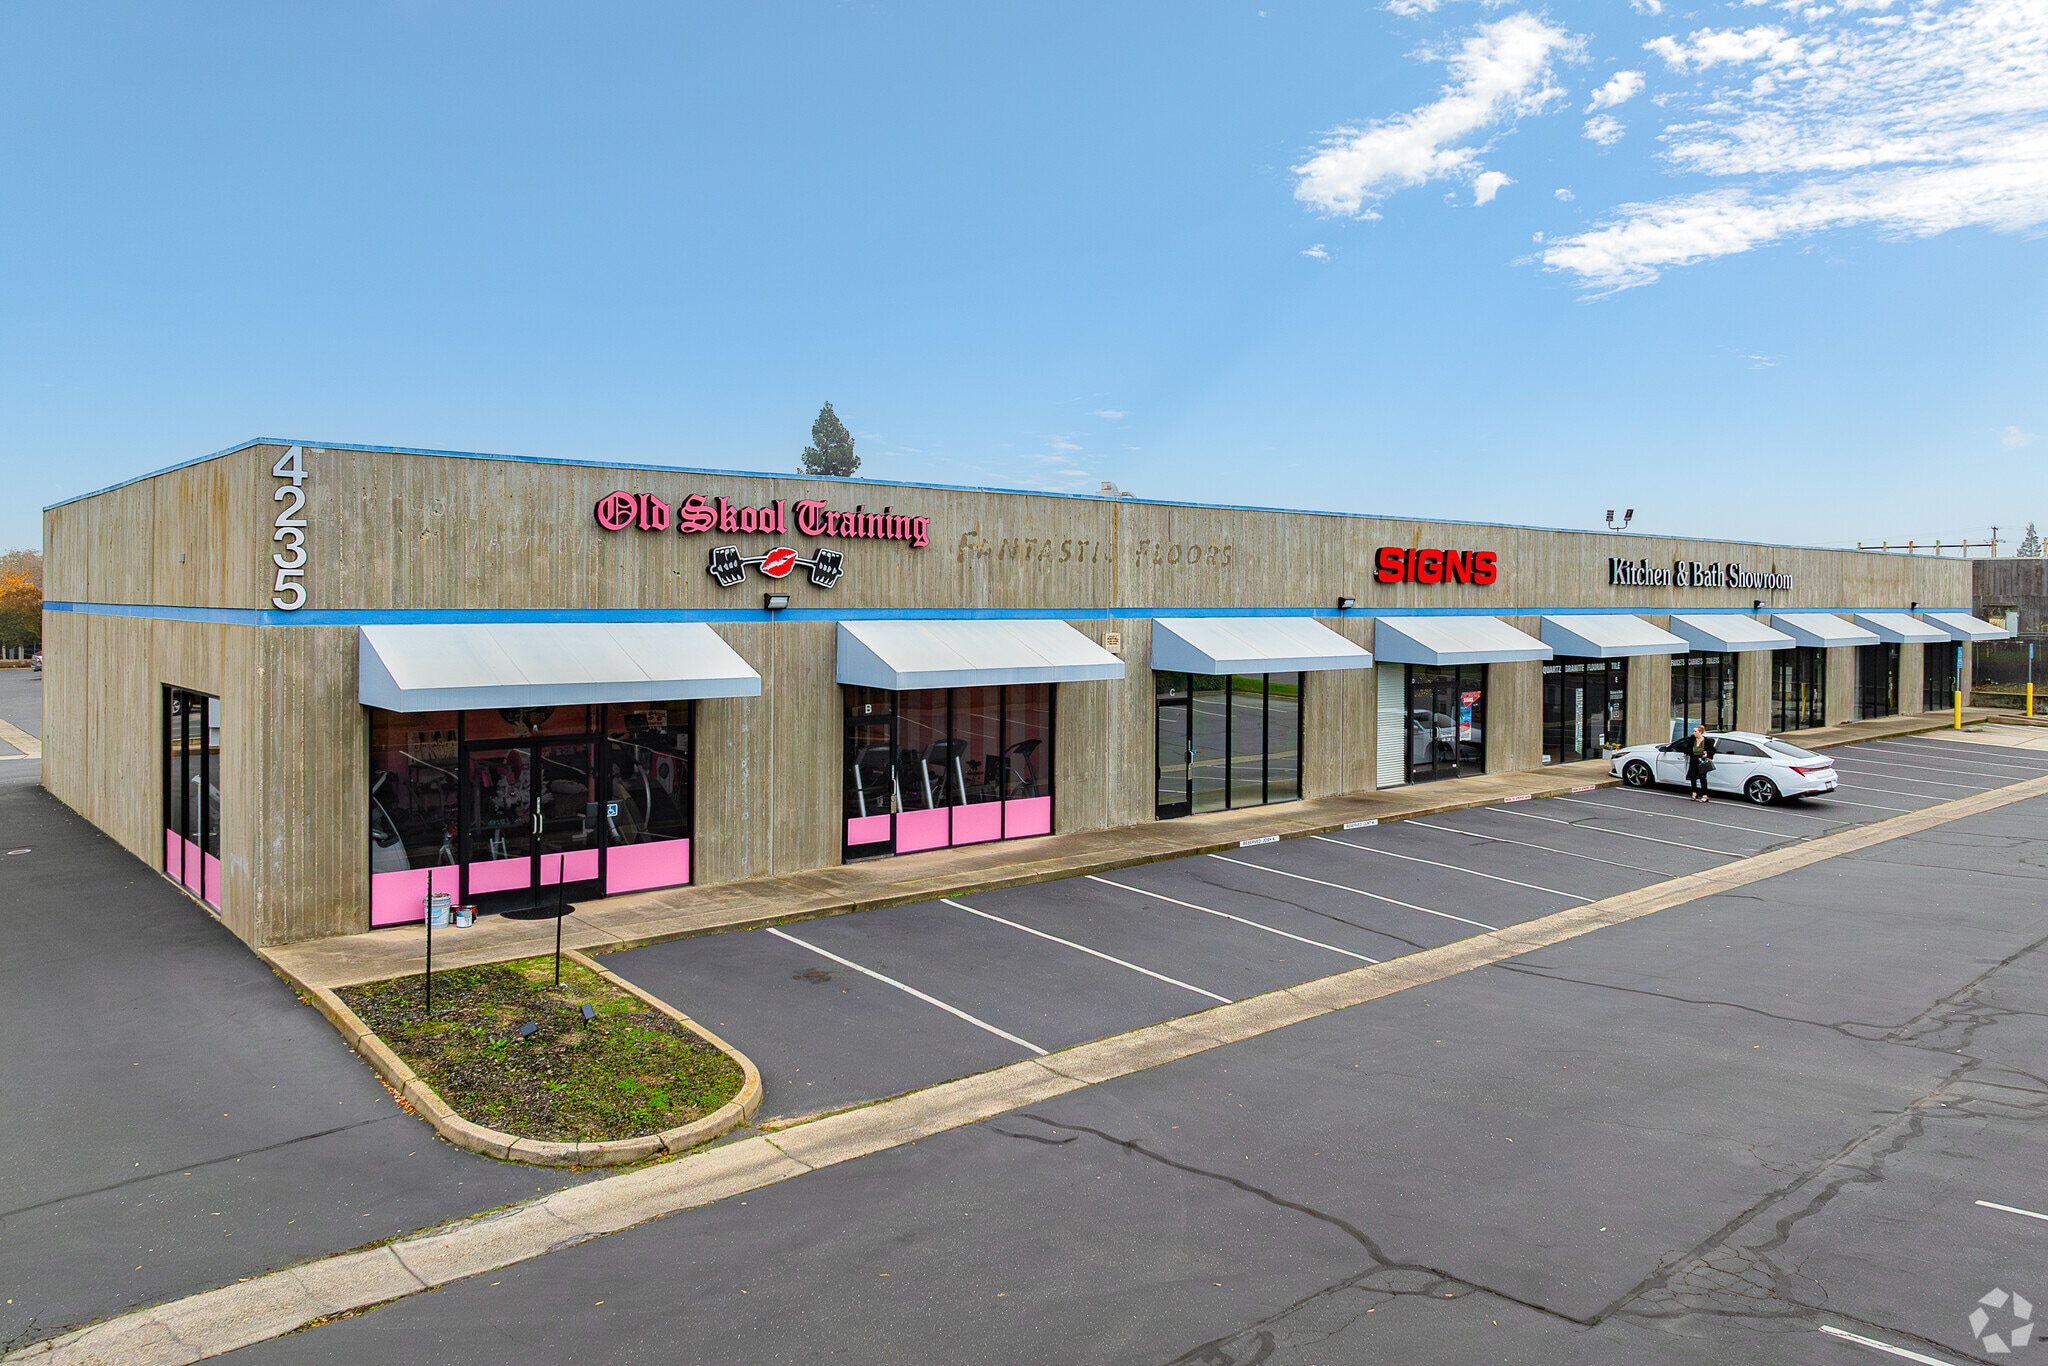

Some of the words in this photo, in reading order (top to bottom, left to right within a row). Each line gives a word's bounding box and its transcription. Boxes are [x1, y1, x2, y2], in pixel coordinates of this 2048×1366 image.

[272, 446, 309, 612] 4235
[596, 490, 671, 532] Old
[678, 493, 788, 535] Skool
[794, 499, 931, 548] Training
[957, 530, 1113, 563] FANTASTI
[1135, 538, 1232, 568] FLOORS
[1376, 546, 1498, 585] SIGNS
[1610, 558, 1672, 587] Kitchen
[1675, 560, 1690, 588] &
[1691, 561, 1727, 588] Bath
[1728, 563, 1793, 591] Showroom
[1543, 665, 1562, 675] QUARTZ
[1564, 663, 1585, 673] GRANITE
[1611, 661, 1621, 670] TILE
[864, 703, 873, 714] B
[1169, 688, 1176, 697] C
[532, 723, 539, 734] A
